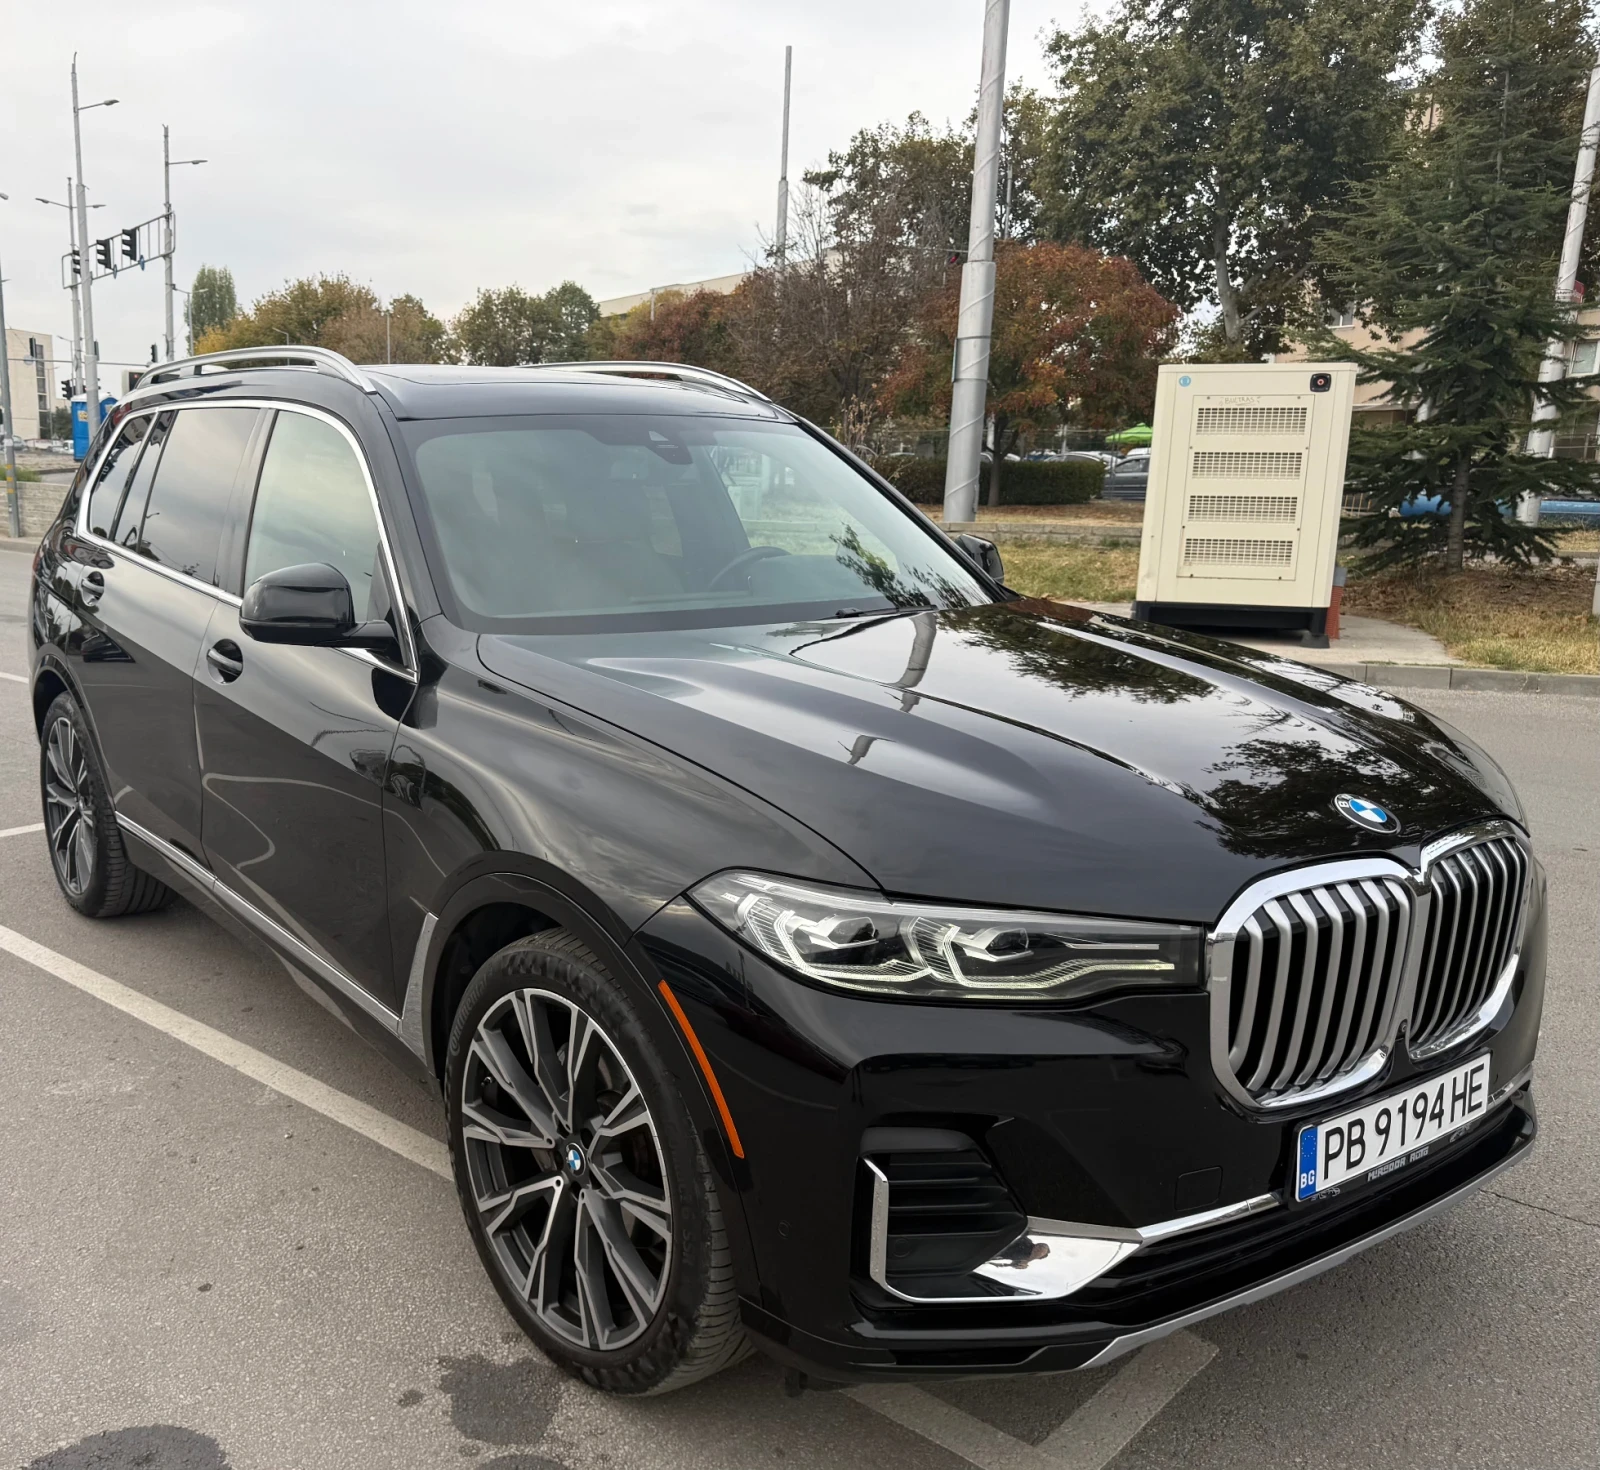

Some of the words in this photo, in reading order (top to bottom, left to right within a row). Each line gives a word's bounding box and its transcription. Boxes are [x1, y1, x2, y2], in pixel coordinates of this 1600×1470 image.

[1323, 1118, 1366, 1180] PB
[1374, 1082, 1445, 1157] 9194
[1450, 1063, 1485, 1123] HE
[1300, 1169, 1315, 1189] BG
